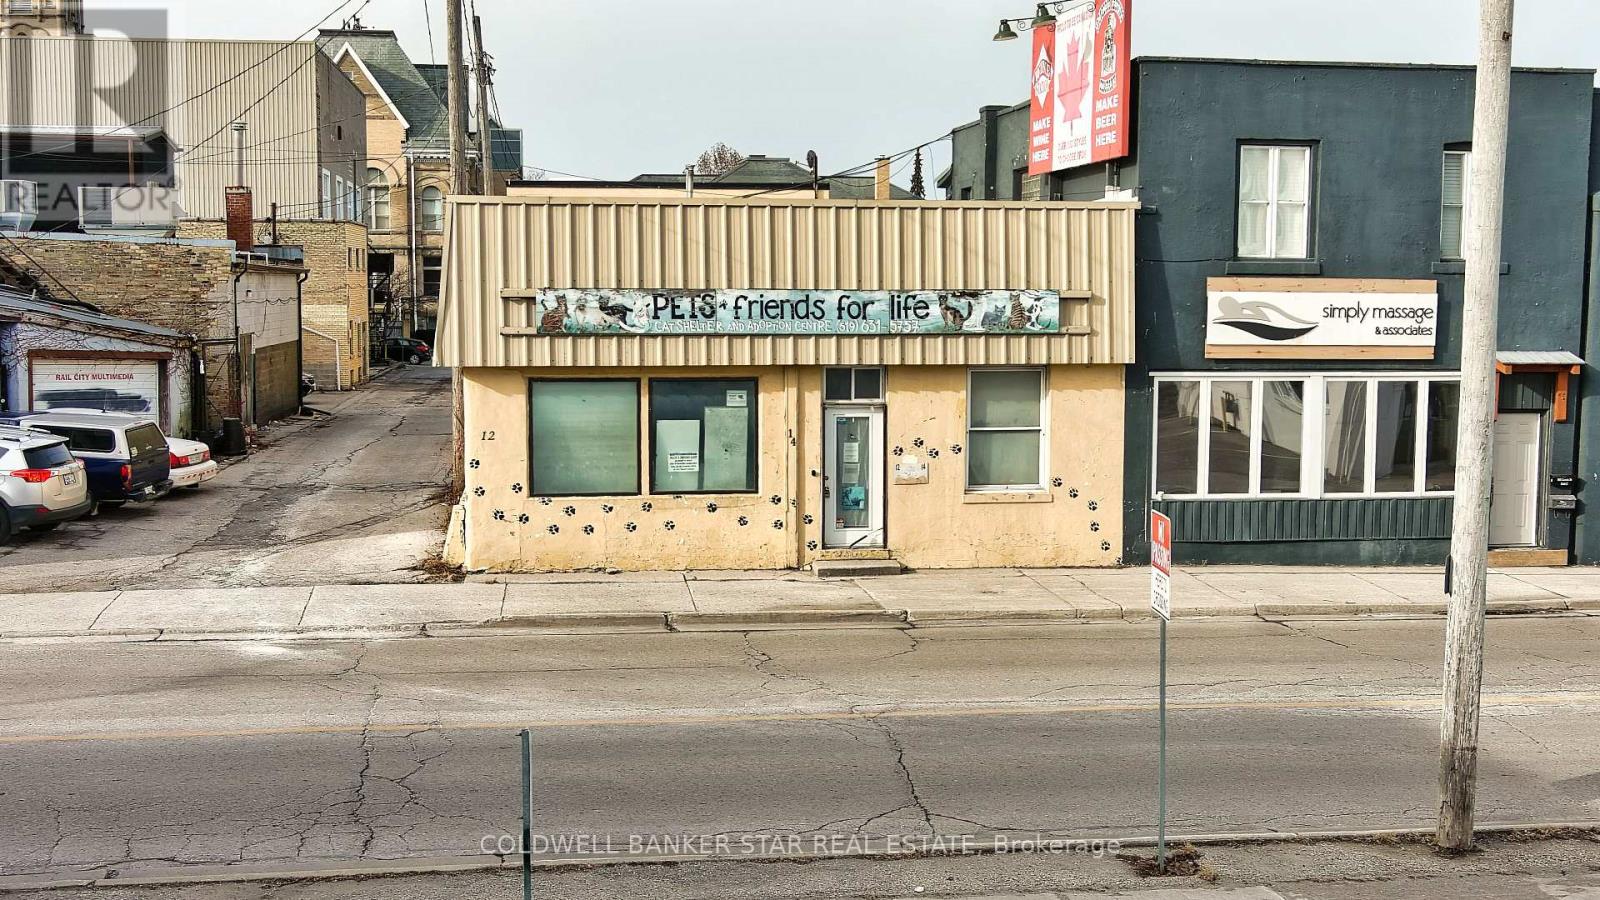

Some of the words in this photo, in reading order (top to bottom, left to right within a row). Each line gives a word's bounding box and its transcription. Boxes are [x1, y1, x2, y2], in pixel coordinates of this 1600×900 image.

[1096, 94, 1119, 113] MAKE
[1033, 116, 1051, 132] MAKE
[1096, 113, 1117, 130] BEER
[1033, 132, 1050, 147] WINE
[1096, 131, 1117, 147] HERE
[1032, 148, 1050, 163] HERE
[652, 292, 717, 320] PETS
[733, 293, 826, 321] friends
[836, 294, 876, 321] for
[890, 293, 931, 320] life
[1322, 300, 1370, 324] simply
[1372, 307, 1434, 324] massage
[654, 320, 675, 334] CAT
[677, 320, 724, 333] SHELTER
[727, 321, 745, 333] AND
[747, 320, 792, 333] ADOPTION
[794, 320, 833, 333] CENTRE
[1375, 326, 1382, 335] &
[1382, 325, 1433, 336] associates
[55, 373, 72, 381] RAIL
[73, 373, 90, 381] CITY
[91, 373, 134, 381] MULTIMEDIA
[480, 430, 496, 441] 12
